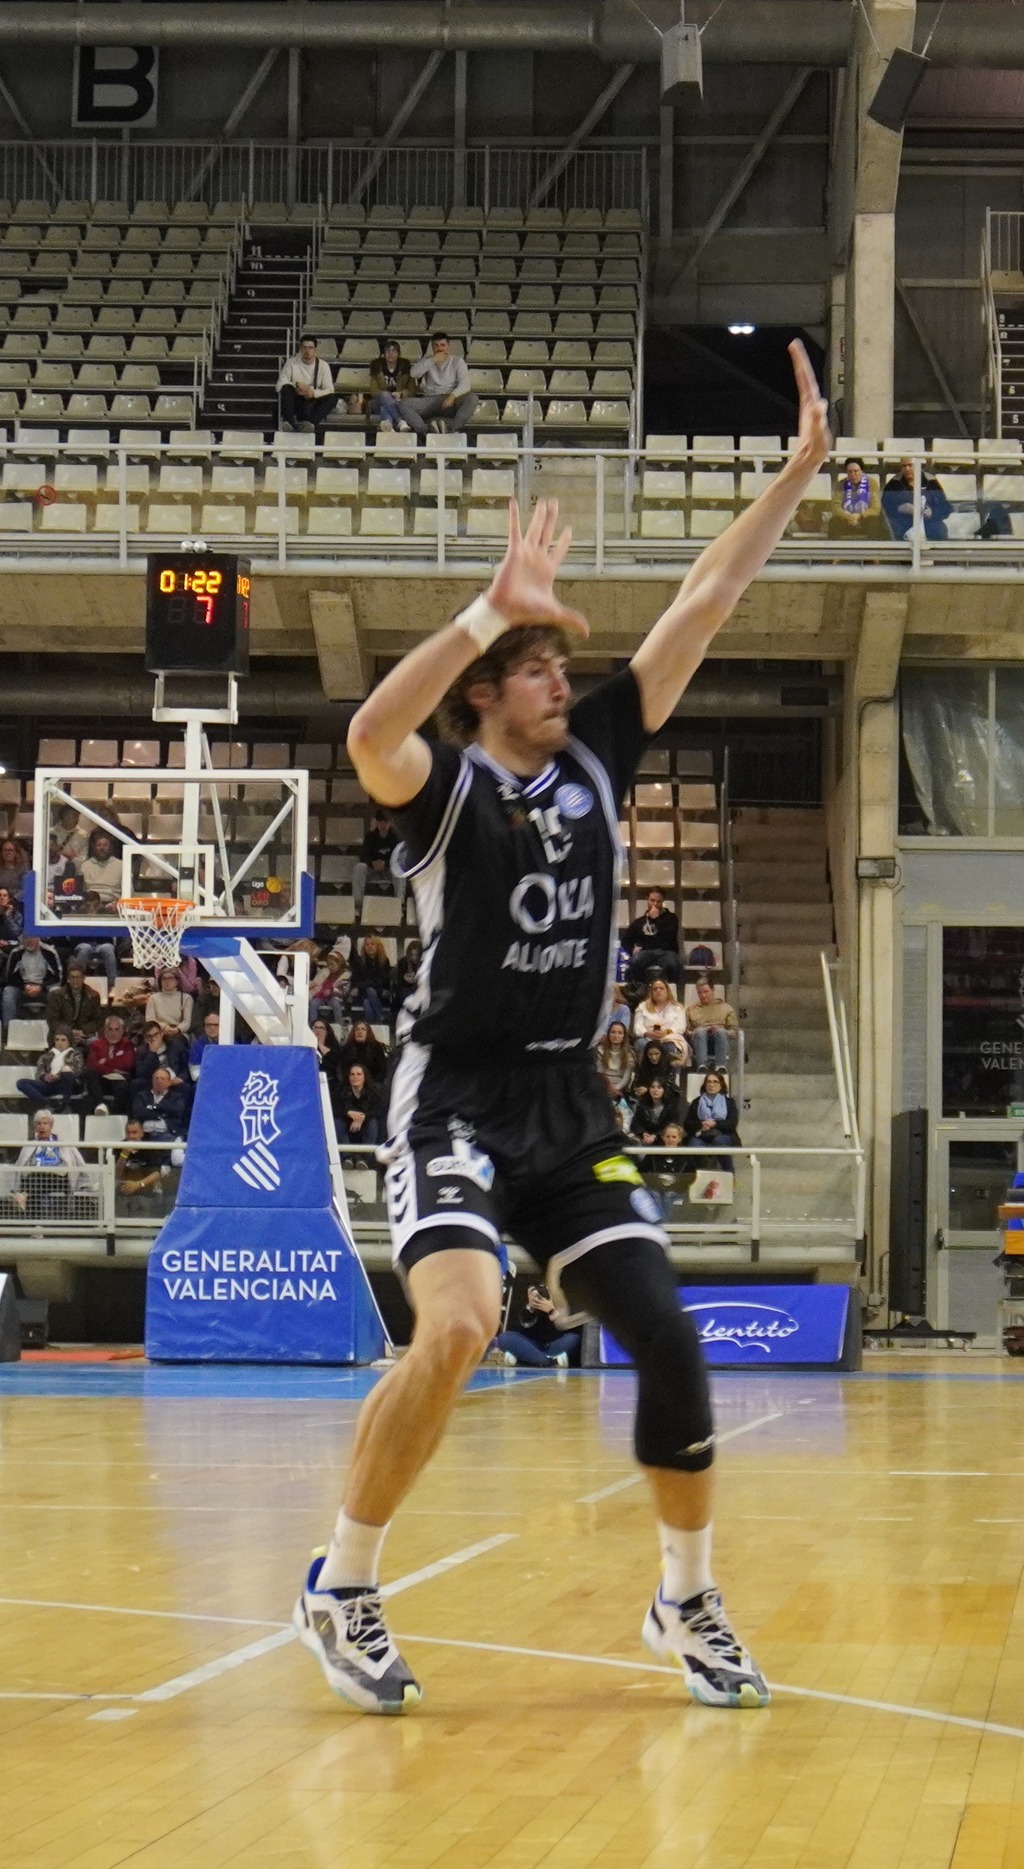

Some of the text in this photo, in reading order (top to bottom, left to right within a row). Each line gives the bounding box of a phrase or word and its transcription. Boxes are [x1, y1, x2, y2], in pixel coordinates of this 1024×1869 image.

[78, 46, 155, 121] B
[160, 570, 223, 594] 01:22
[196, 595, 214, 624] 7
[161, 1249, 342, 1273] GENERALITAT
[163, 1278, 337, 1301] VALENCIANA
